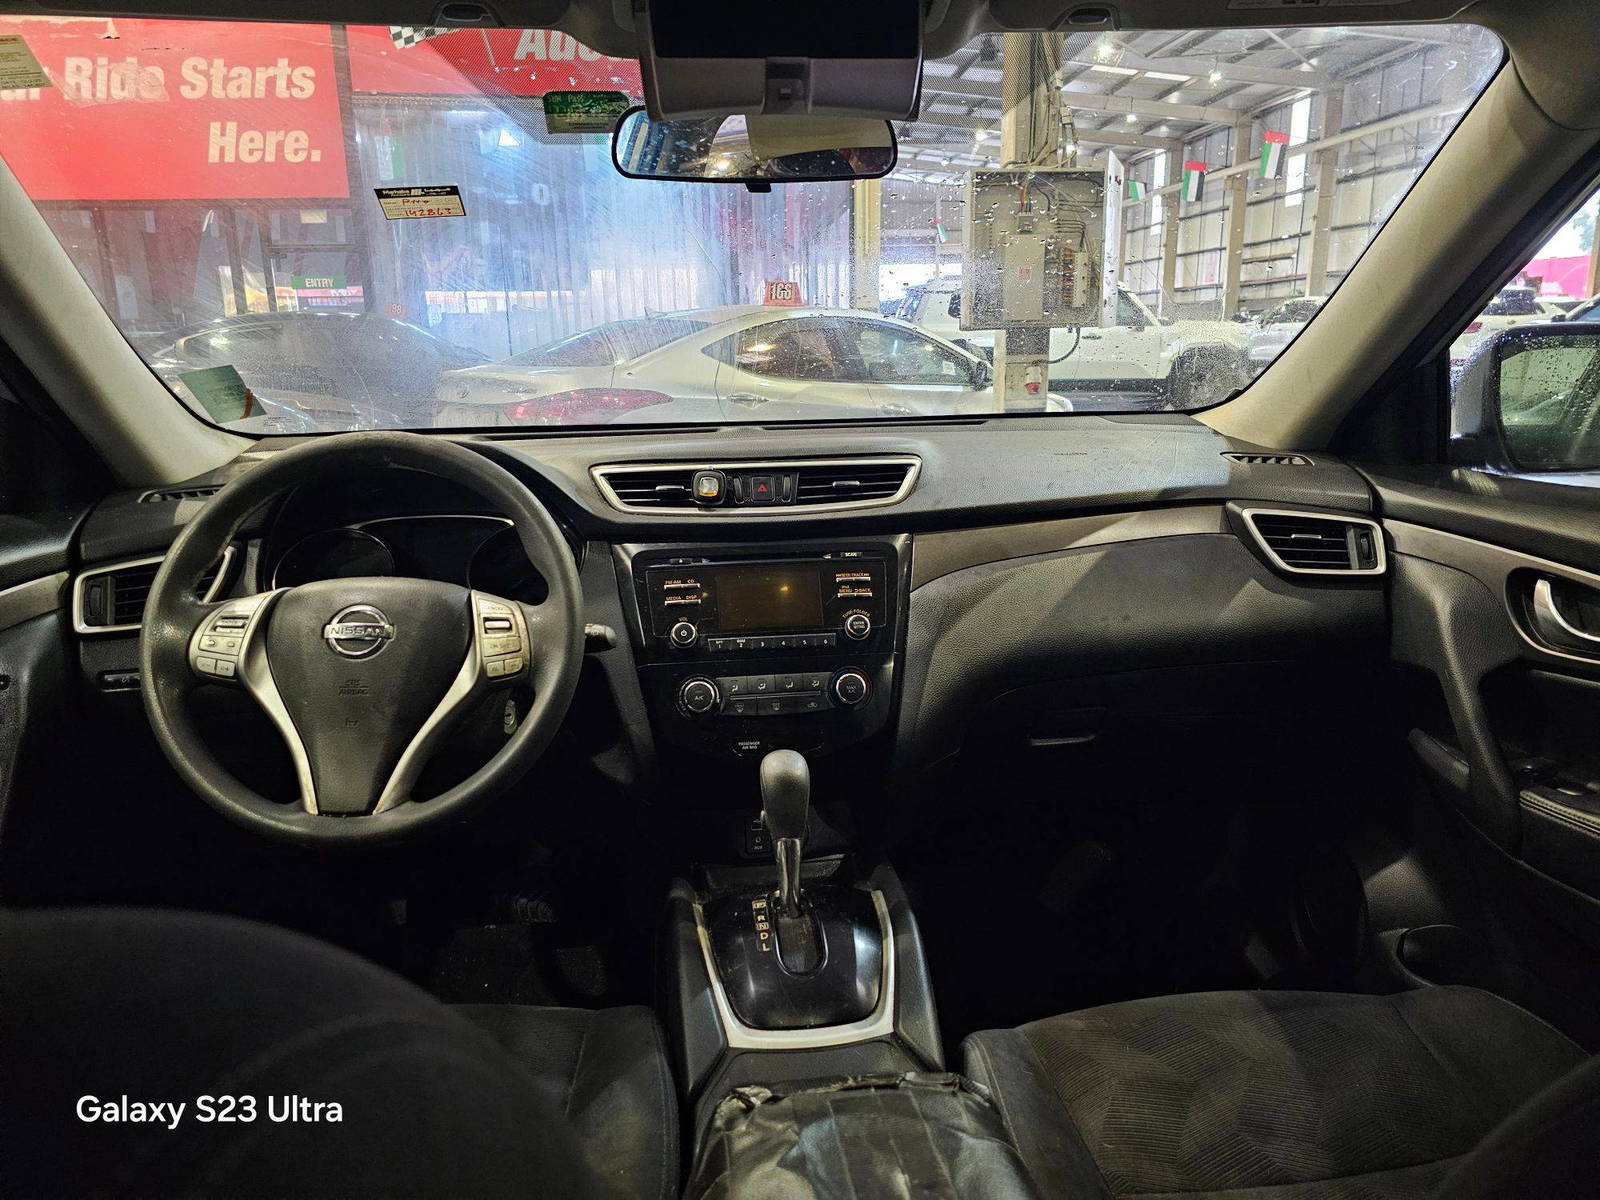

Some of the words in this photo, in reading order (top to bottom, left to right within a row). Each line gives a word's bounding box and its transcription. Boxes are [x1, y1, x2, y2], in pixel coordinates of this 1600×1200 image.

[63, 56, 165, 101] Ride
[179, 56, 316, 100] Starts
[208, 121, 322, 163] Here.
[305, 278, 334, 288] ENTRY
[330, 626, 386, 636] NISSAN
[760, 932, 768, 940] D
[762, 943, 770, 951] L
